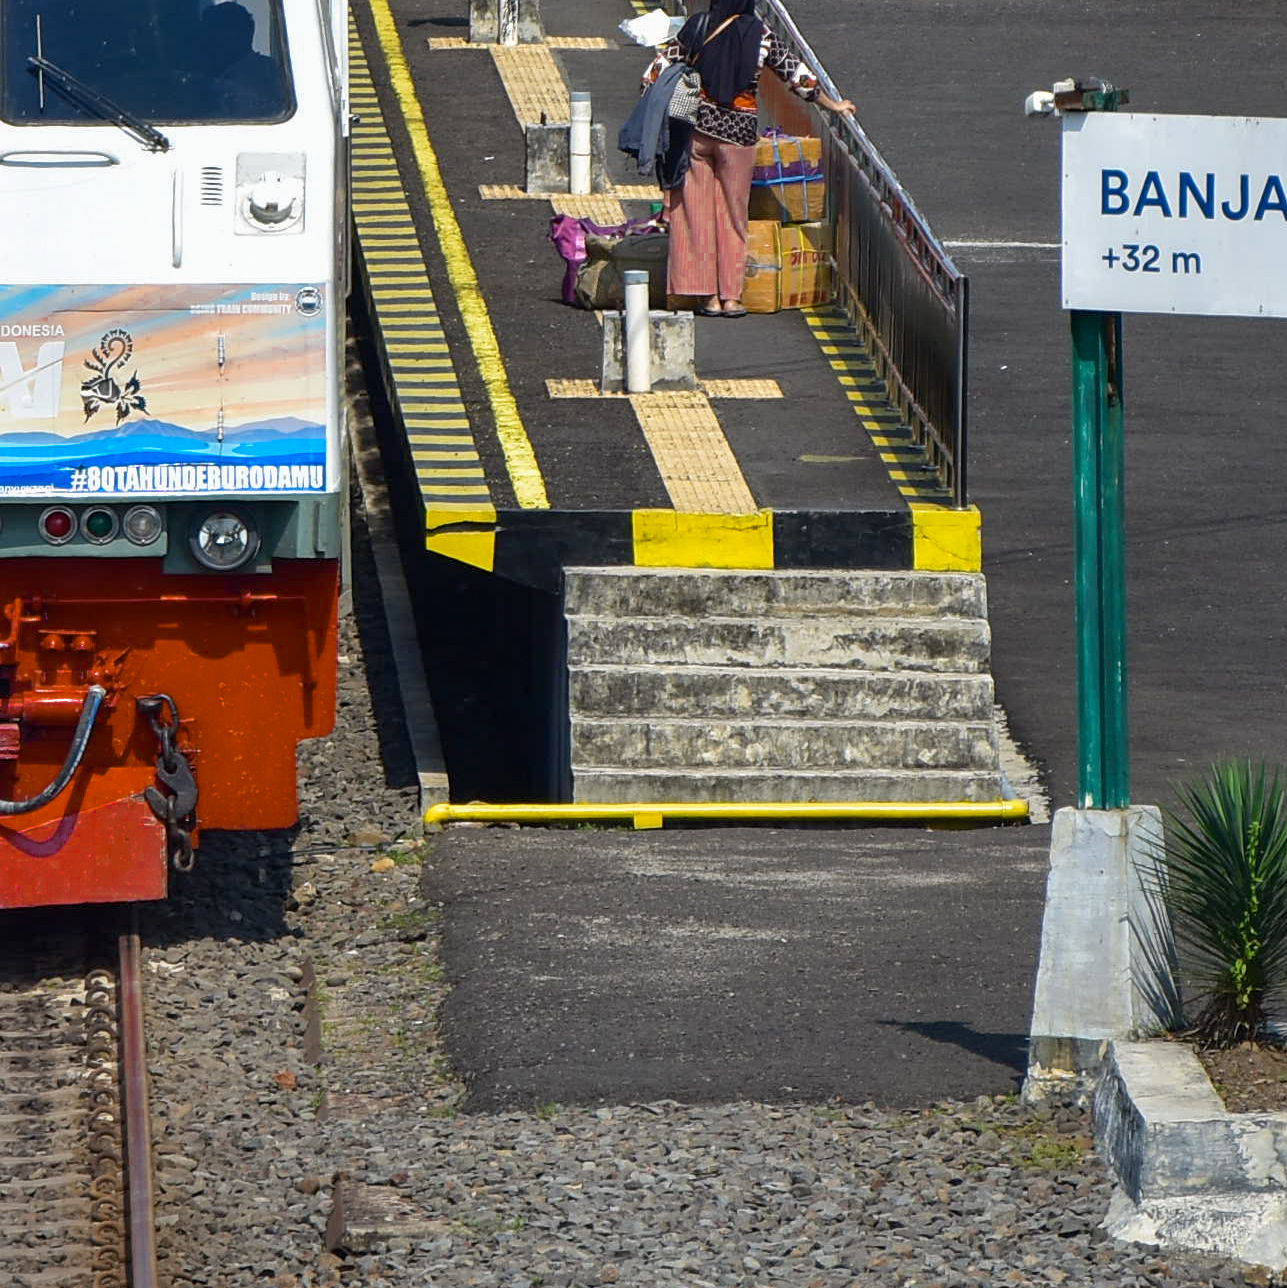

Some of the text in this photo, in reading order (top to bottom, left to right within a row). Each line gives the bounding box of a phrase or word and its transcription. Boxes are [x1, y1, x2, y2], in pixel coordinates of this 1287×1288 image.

[1101, 243, 1201, 274] +32 m
[70, 464, 324, 492] #80TAHUNDEBURODAMU
